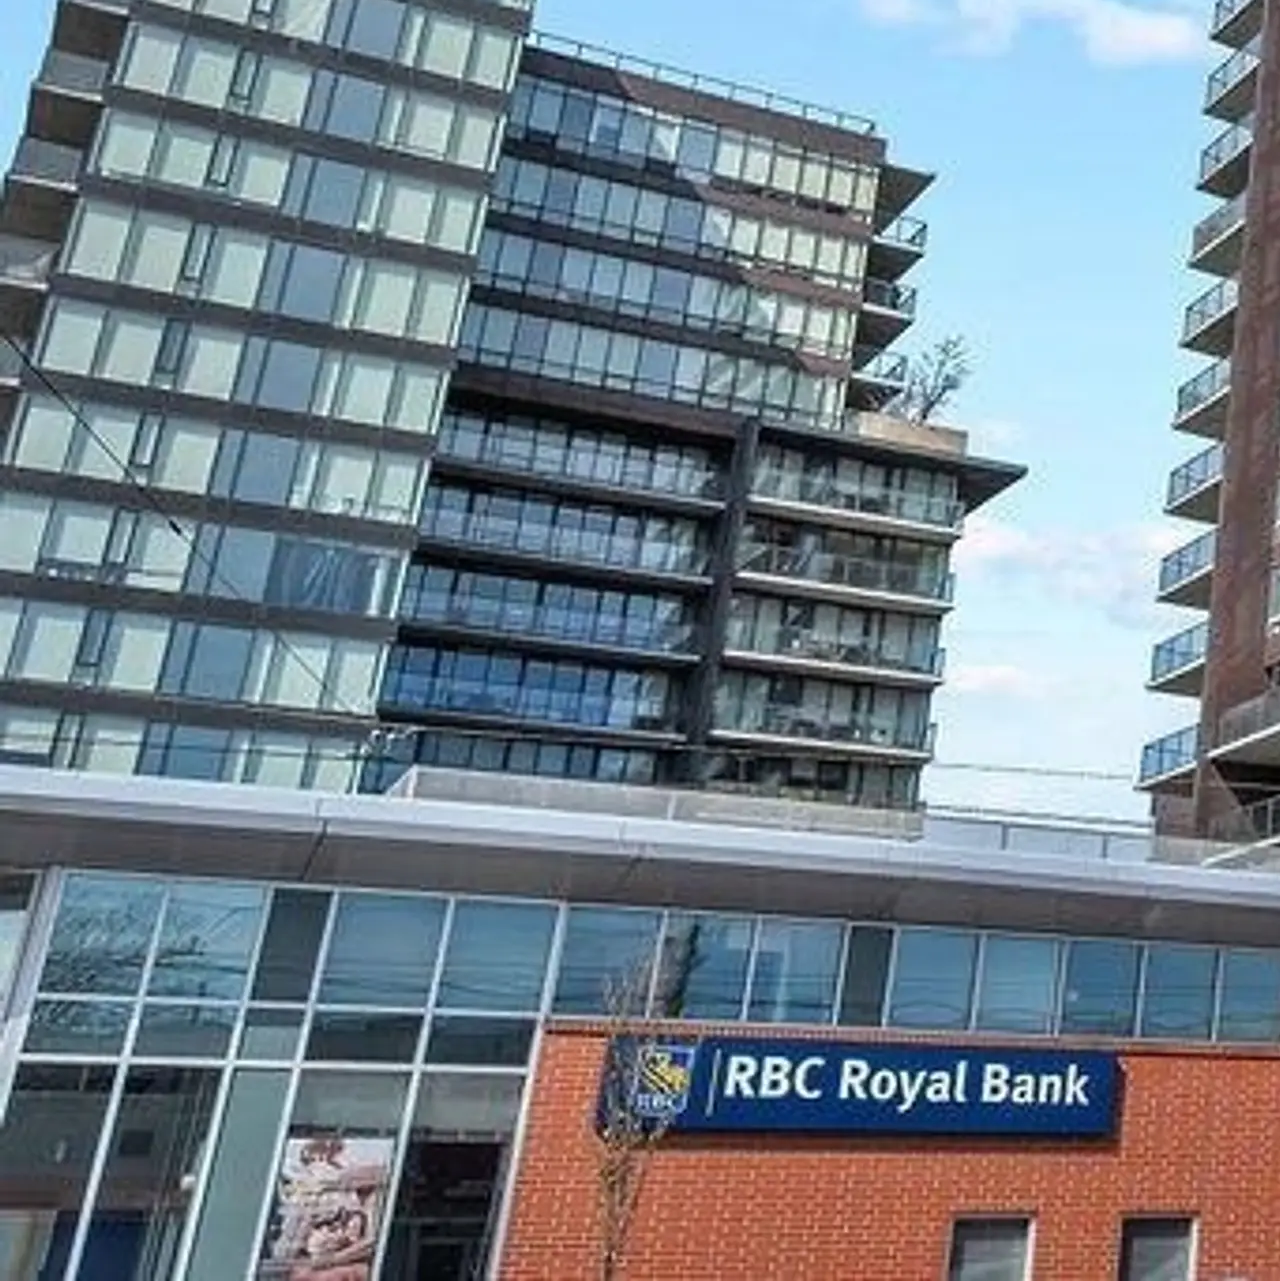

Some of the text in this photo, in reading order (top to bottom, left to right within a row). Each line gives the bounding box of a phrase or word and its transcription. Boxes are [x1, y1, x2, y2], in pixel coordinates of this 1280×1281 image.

[723, 1055, 1090, 1112] RBC Royal Bank
